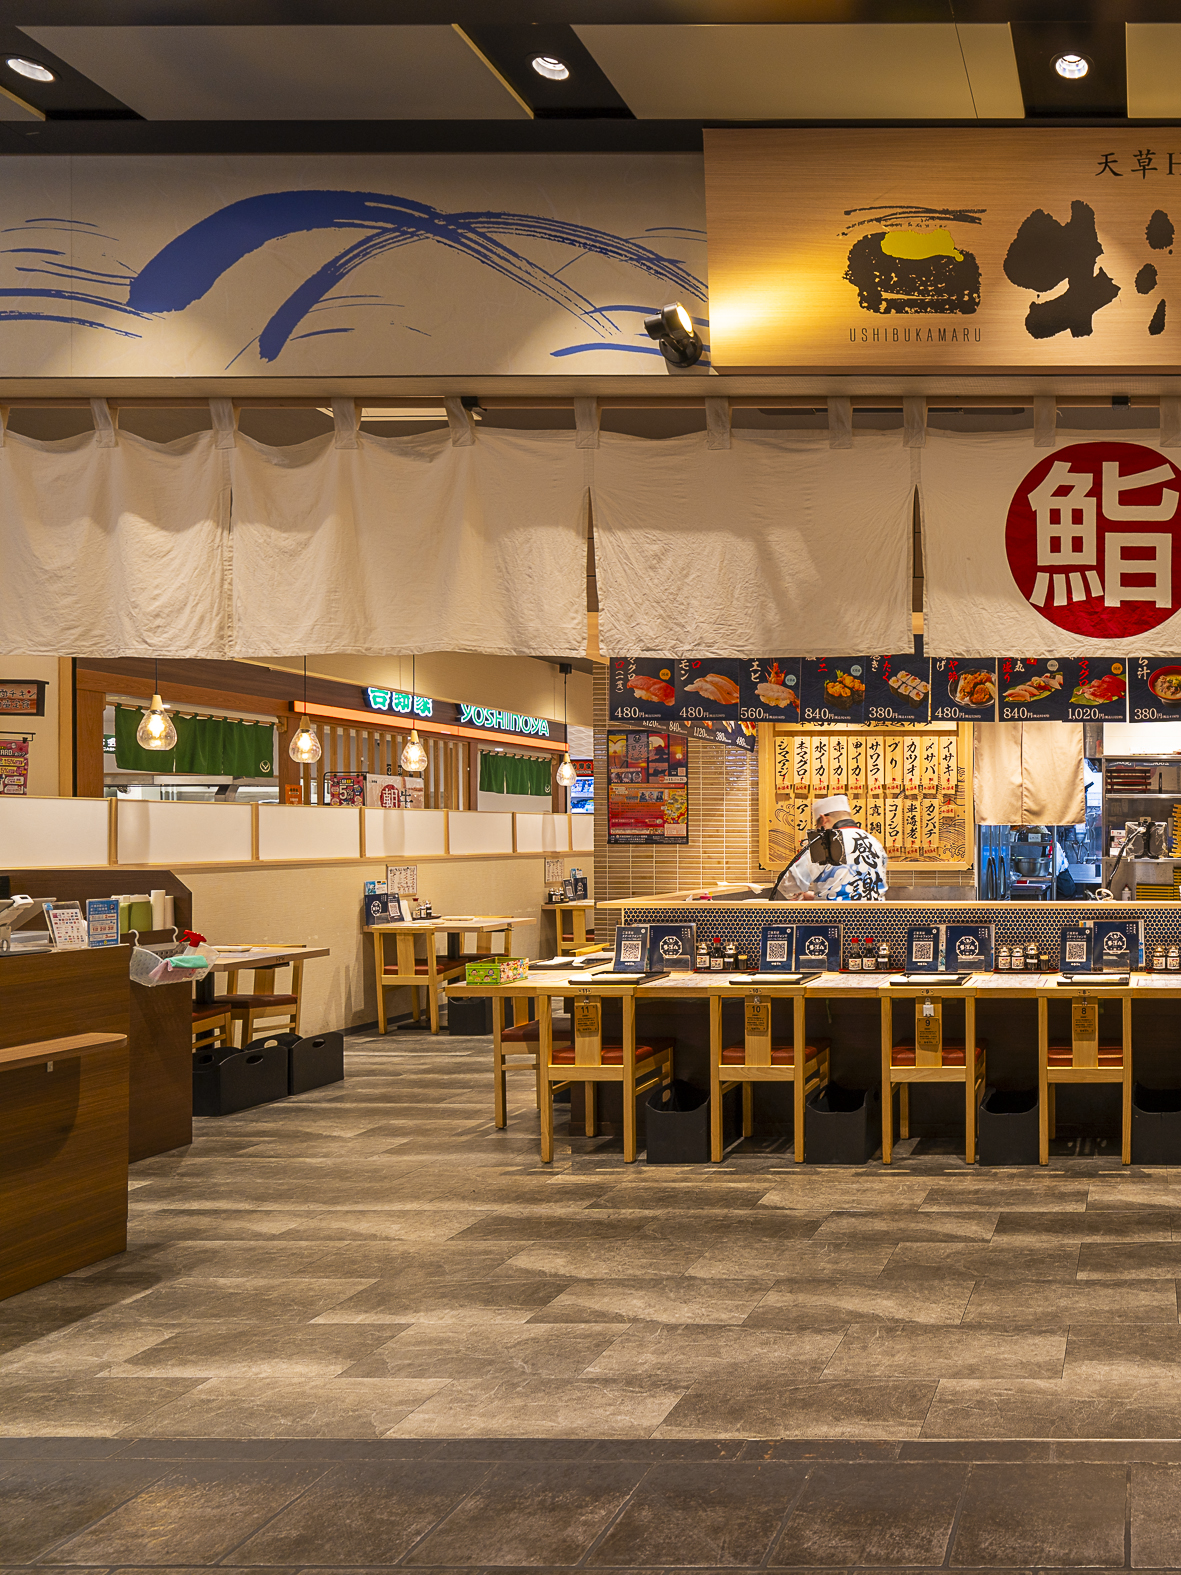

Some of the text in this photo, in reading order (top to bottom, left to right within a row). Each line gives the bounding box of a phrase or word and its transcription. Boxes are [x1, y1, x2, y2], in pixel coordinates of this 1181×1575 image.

[849, 327, 982, 343] USHIBUKAMARU
[1027, 460, 1180, 609] 鮨
[1078, 657, 1089, 687] マグロ
[368, 687, 433, 717] 吉野家
[460, 703, 549, 737] YOSHINOYA
[777, 740, 790, 777] シマアジ
[796, 740, 808, 777] 本マグロ
[814, 740, 827, 777] 水イカ
[832, 740, 844, 777] 赤イカ
[851, 741, 863, 777] 甲イカ
[868, 741, 881, 777] サワラ
[906, 741, 918, 777] カツオ
[942, 741, 955, 777] イサキ
[796, 803, 809, 831] アジ
[869, 803, 882, 835] 真鯛
[887, 802, 900, 838] コノシロ
[906, 803, 918, 839] 車海老
[850, 832, 883, 900] 感謝
[581, 1006, 589, 1014] 11
[1081, 1007, 1087, 1015] 8
